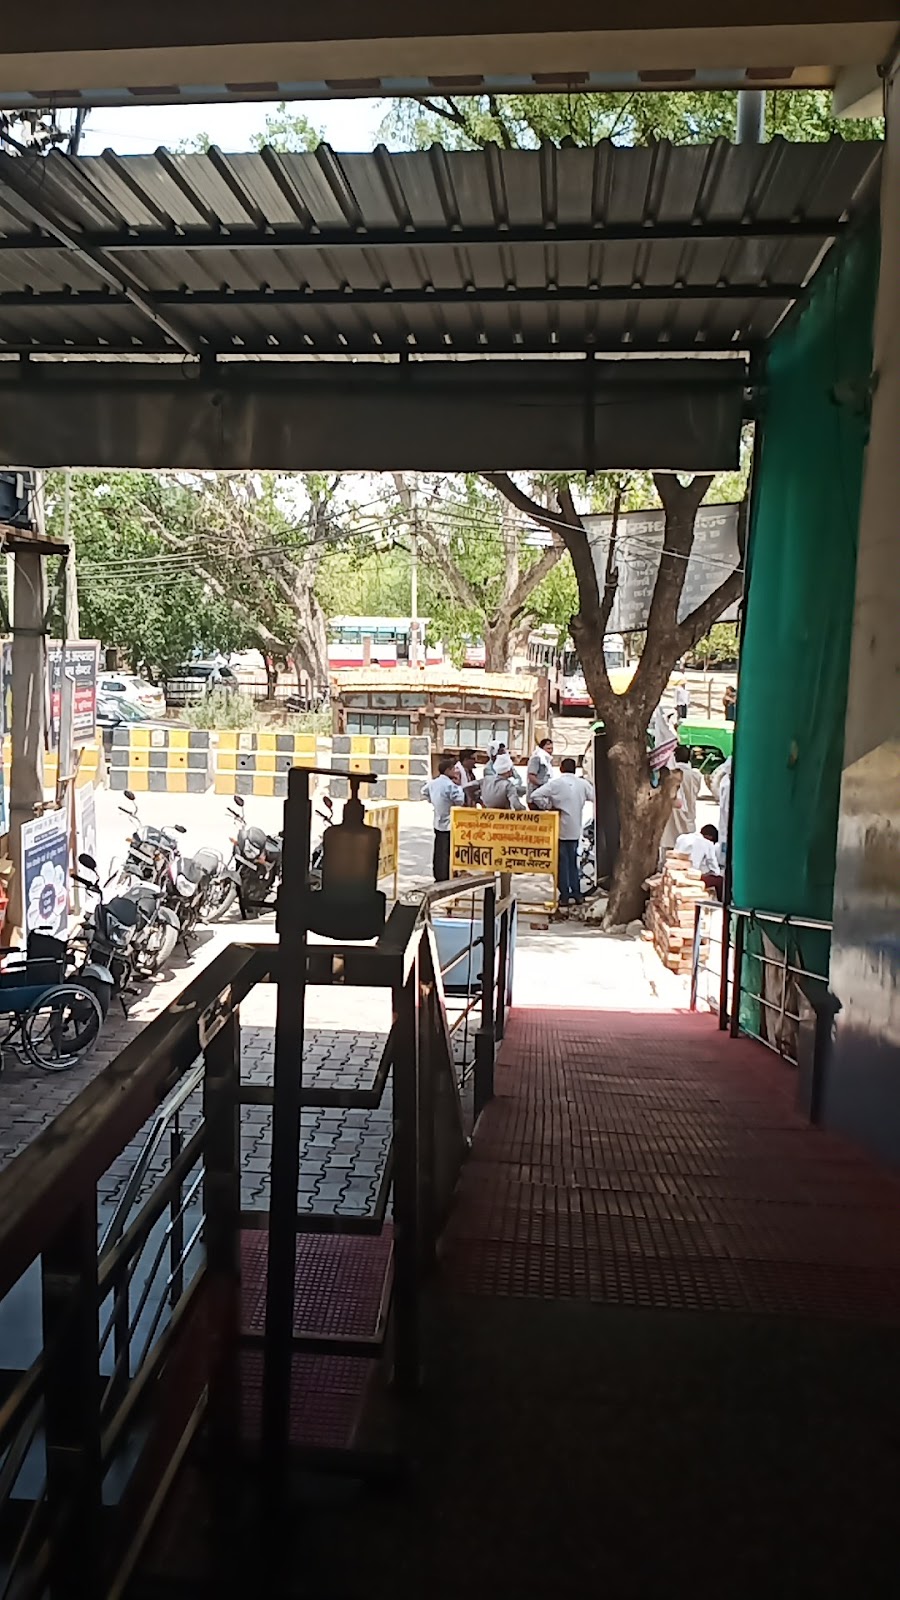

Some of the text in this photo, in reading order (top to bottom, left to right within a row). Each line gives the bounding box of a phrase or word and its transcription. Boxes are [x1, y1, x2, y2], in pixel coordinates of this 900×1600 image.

[499, 812, 540, 823] PARKING
[460, 830, 472, 840] 24
[454, 841, 551, 866] ग्लोबल अस्पताल
